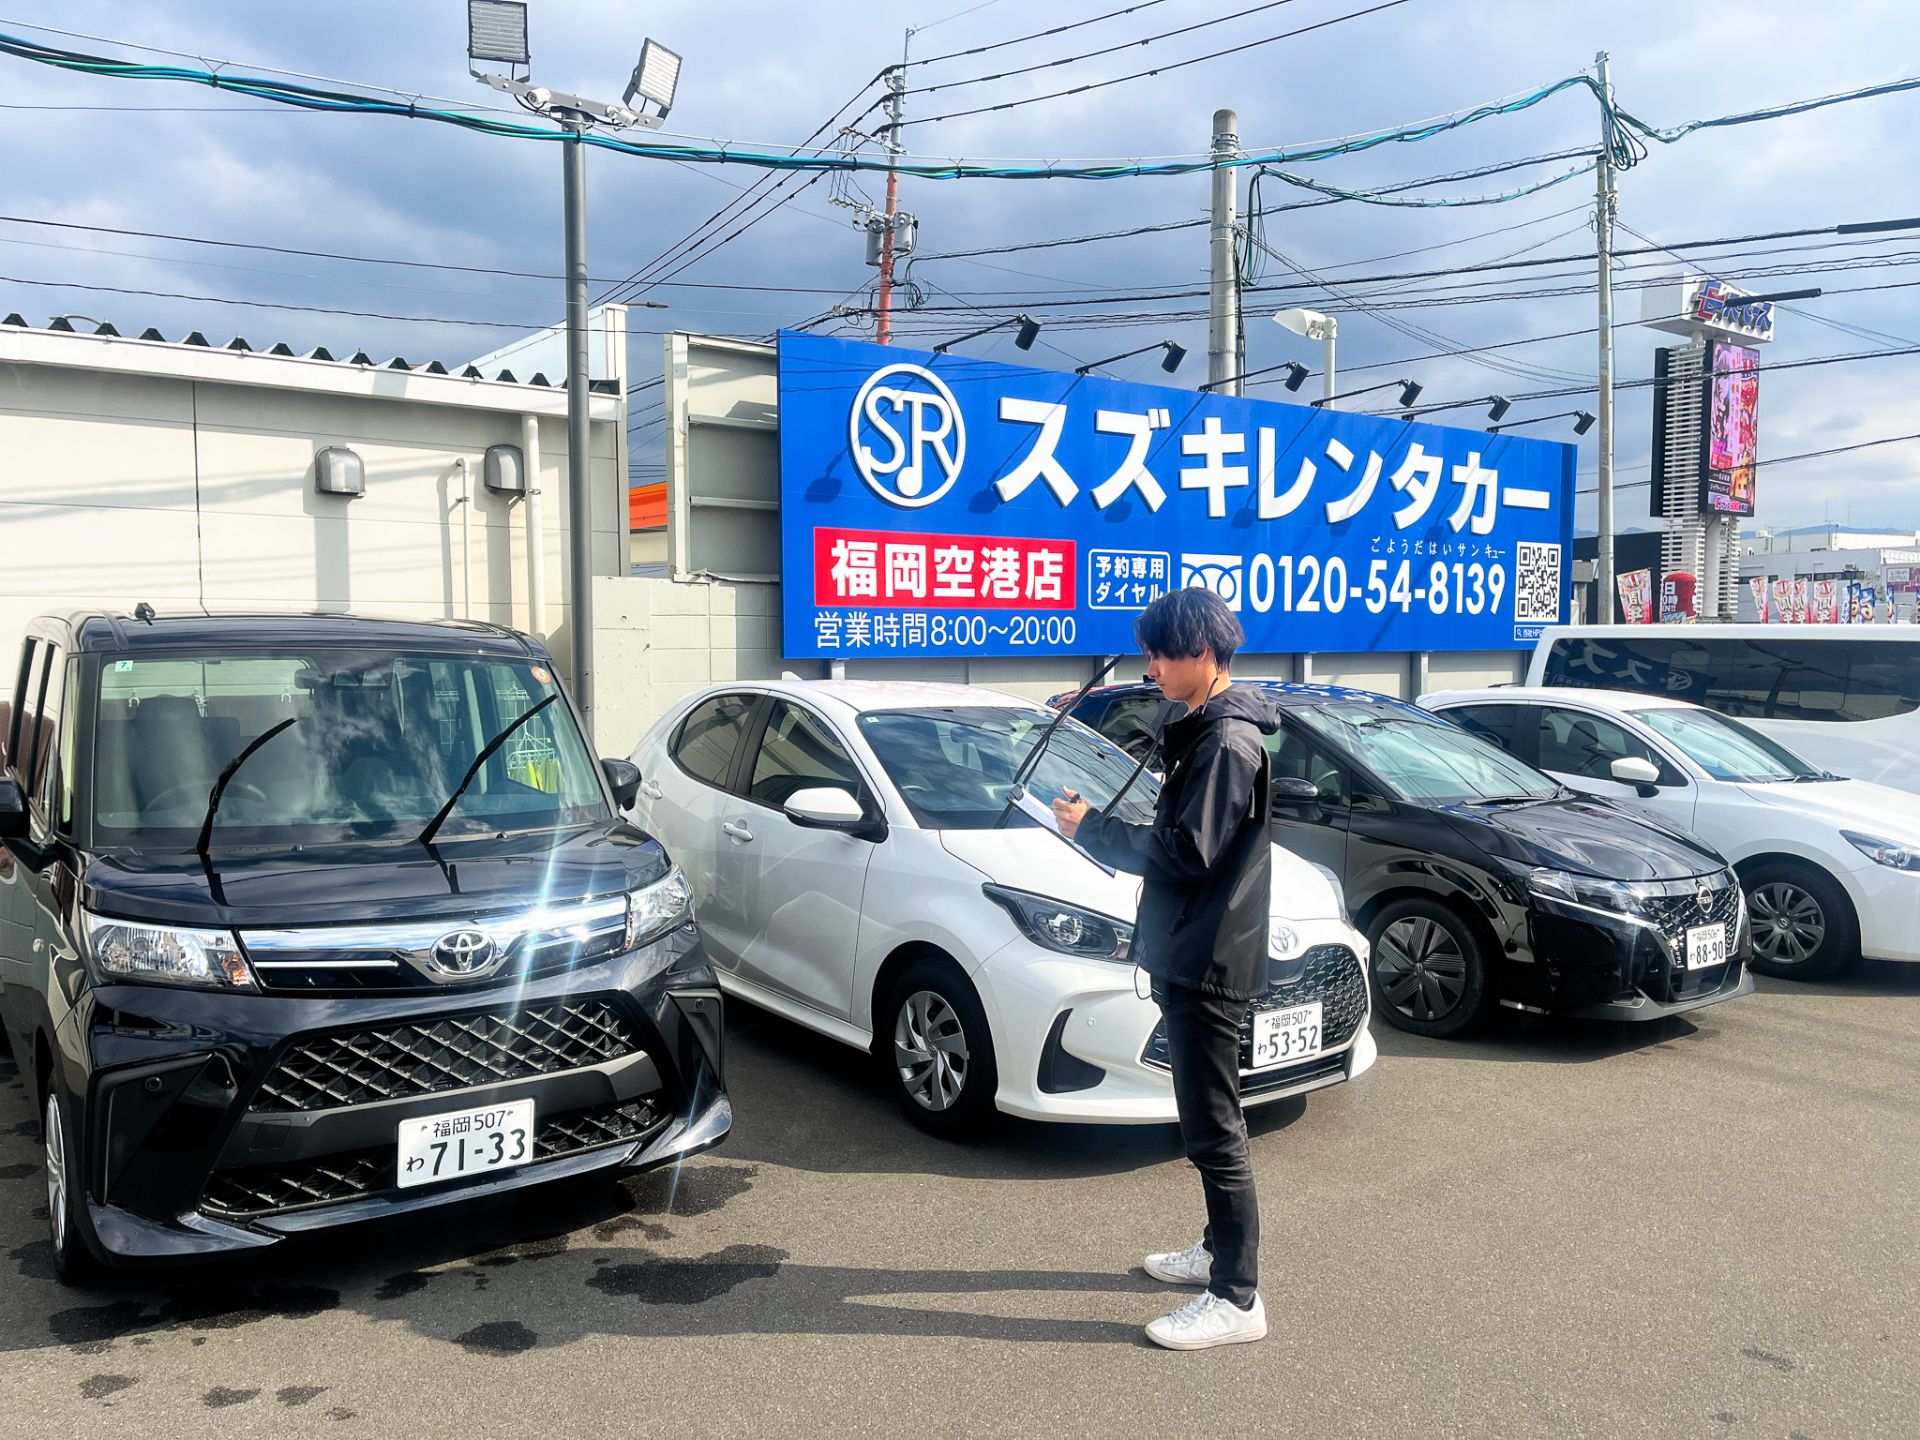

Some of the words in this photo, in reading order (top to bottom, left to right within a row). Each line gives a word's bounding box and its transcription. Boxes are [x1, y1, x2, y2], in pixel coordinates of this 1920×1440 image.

[993, 397, 1551, 536] スズキレンタカー
[831, 539, 1063, 601] 福岡空港店
[1095, 556, 1165, 579] 予約専用
[1095, 582, 1165, 604] ダイヤル
[1249, 553, 1506, 615] 0120-54-8139
[1696, 940, 1724, 965] 88-90
[1271, 1013, 1291, 1030] 福岡
[1291, 1010, 1309, 1026] 507
[1257, 1043, 1268, 1055] わ
[1269, 1025, 1318, 1059] 53-52
[433, 1116, 471, 1138] 福岡
[474, 1110, 506, 1131] 507
[406, 1156, 425, 1173] わ
[430, 1128, 526, 1176] 71-33
